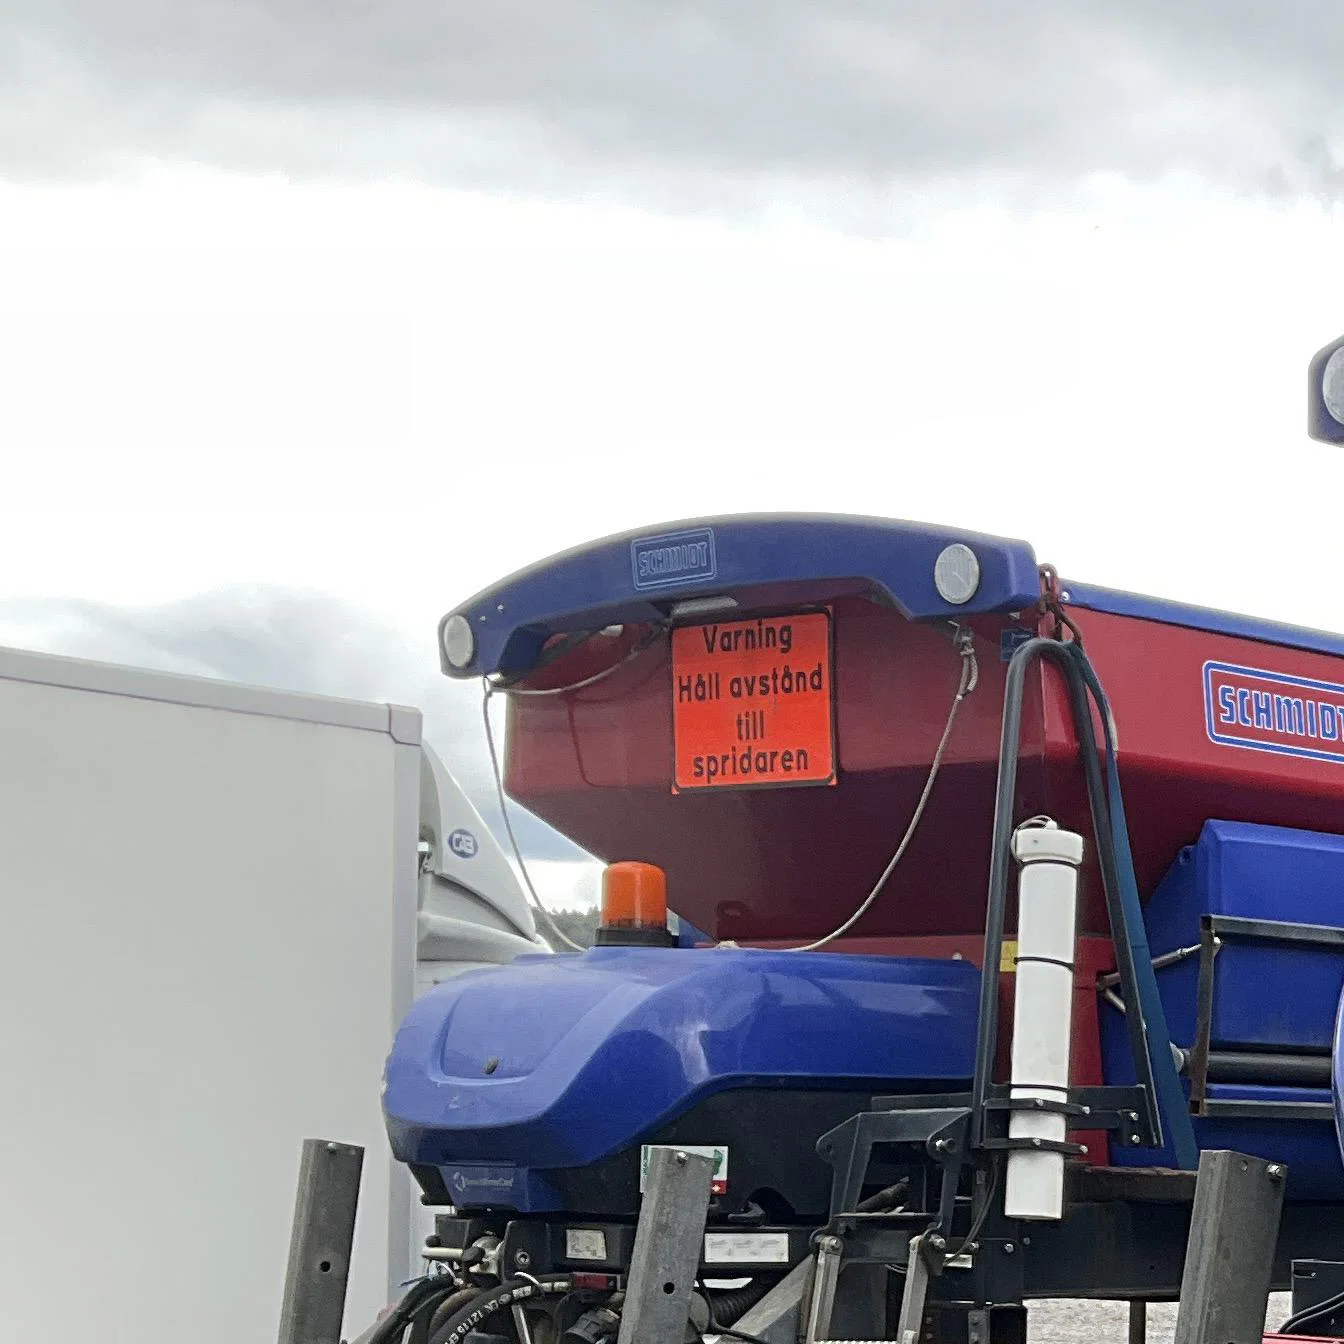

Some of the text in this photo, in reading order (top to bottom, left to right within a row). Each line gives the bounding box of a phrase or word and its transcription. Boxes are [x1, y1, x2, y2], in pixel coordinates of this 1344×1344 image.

[638, 541, 708, 577] SCHMIDT
[702, 619, 793, 654] Varning
[678, 662, 822, 703] Håll avstånd
[736, 710, 765, 740] till
[693, 745, 808, 784] spridaren
